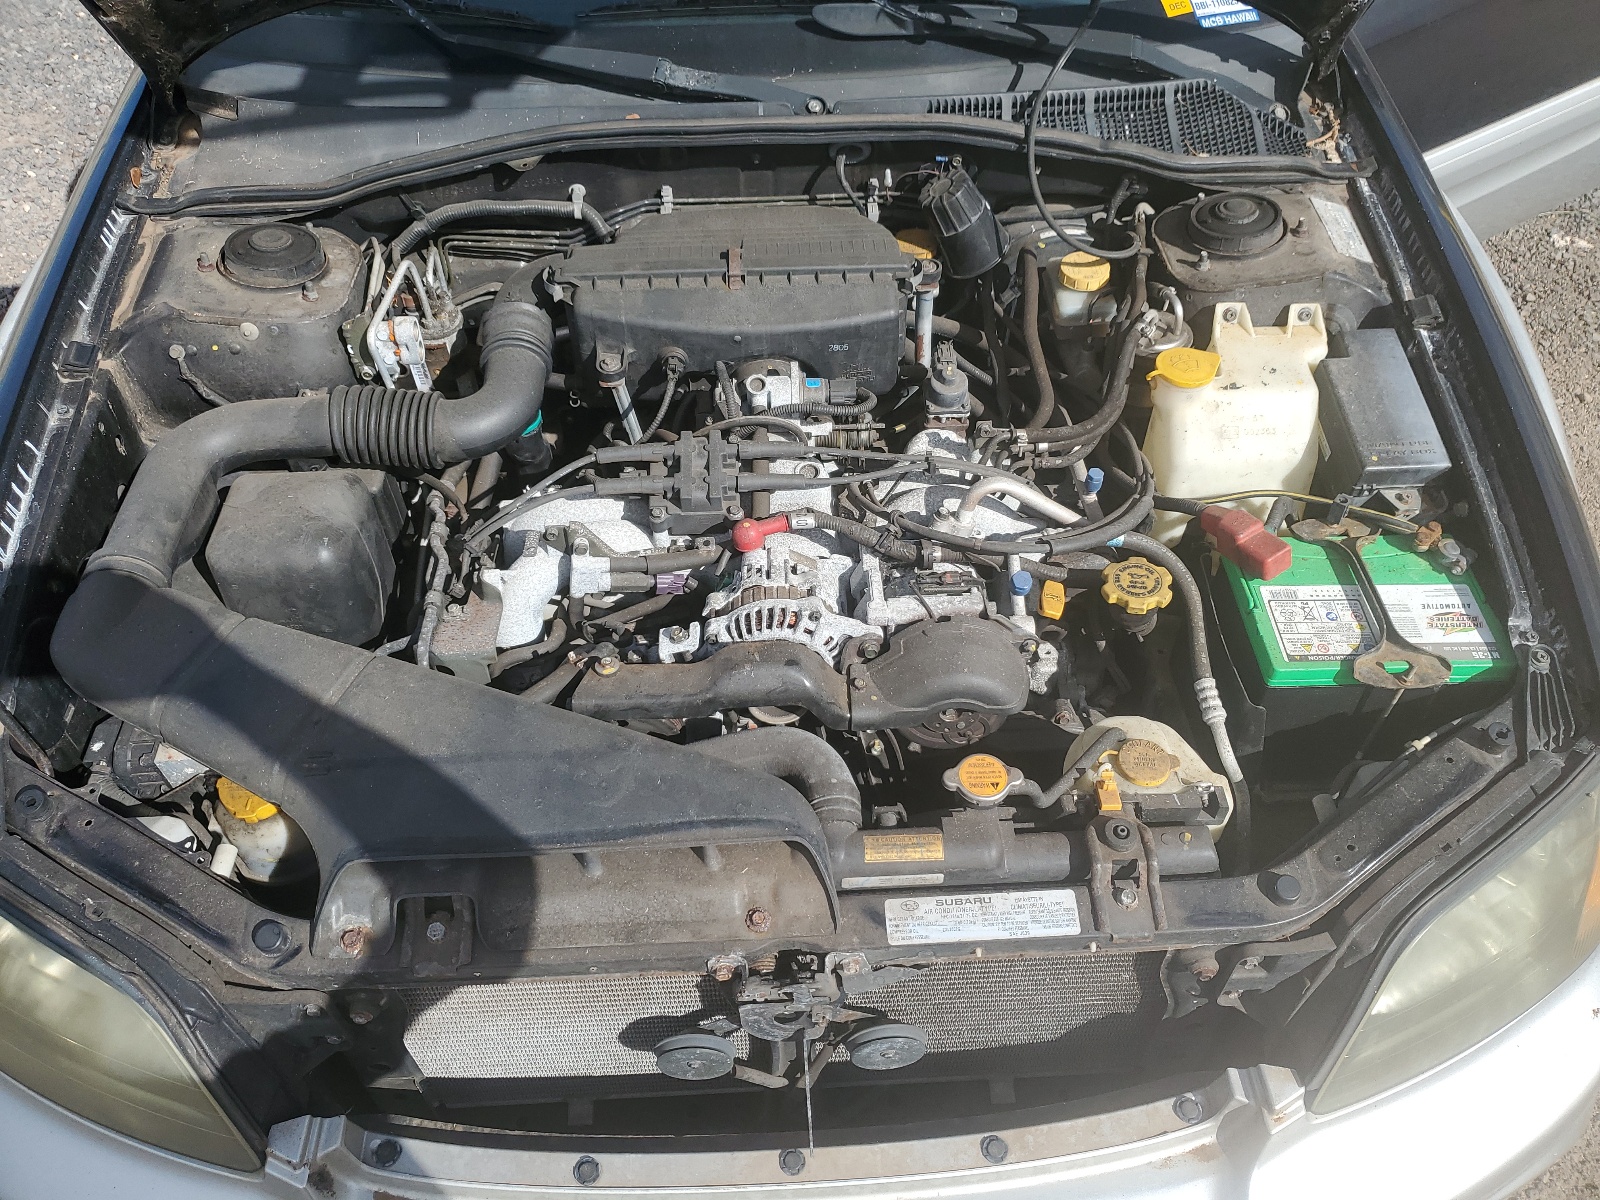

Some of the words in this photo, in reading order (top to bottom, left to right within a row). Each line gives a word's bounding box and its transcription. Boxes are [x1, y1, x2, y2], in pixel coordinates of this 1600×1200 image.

[1169, 2, 1187, 11] DEC
[1201, 16, 1223, 28] MCB
[1225, 12, 1257, 24] HAWAII
[935, 897, 992, 907] SUBARU
